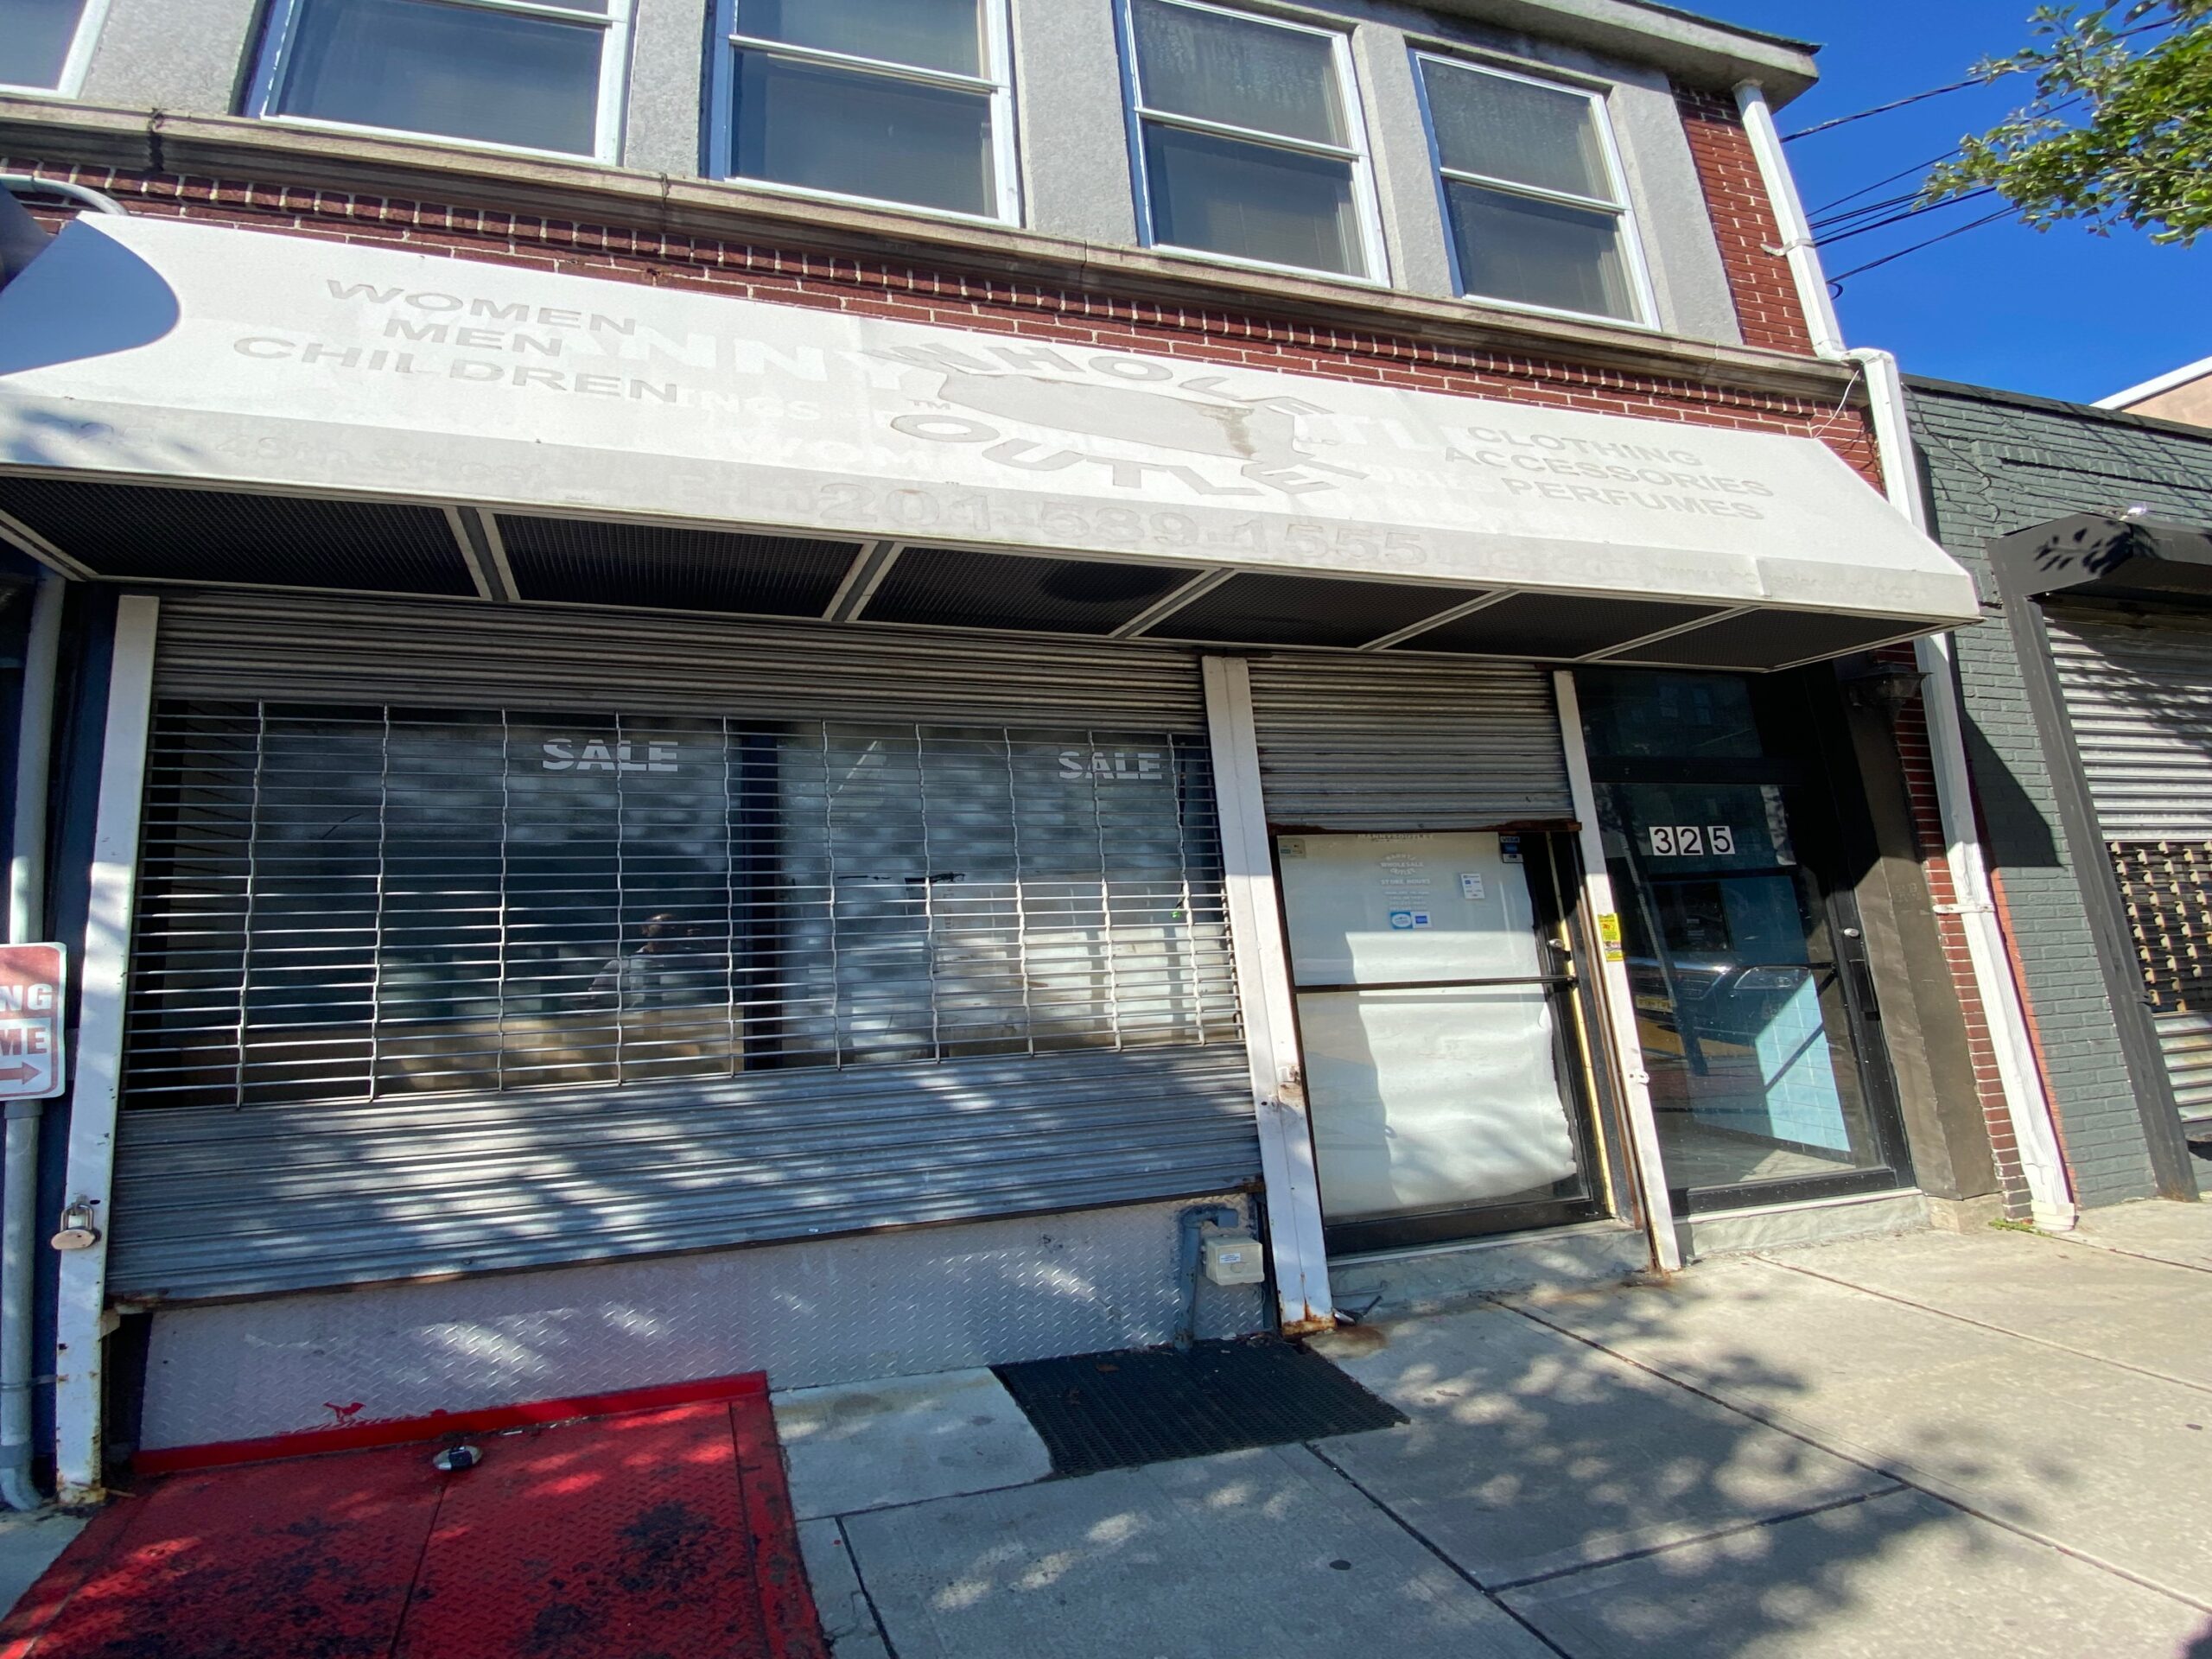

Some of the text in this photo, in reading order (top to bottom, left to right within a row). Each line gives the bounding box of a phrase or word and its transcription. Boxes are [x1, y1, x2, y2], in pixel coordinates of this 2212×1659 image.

[327, 280, 636, 335] WOMEN
[383, 319, 563, 357] MEN
[233, 337, 677, 403] CHILDREN
[1467, 426, 1703, 467] CLOTHING
[1445, 446, 1774, 499] ACCESSORIES
[1500, 477, 1765, 520] PERFUMES
[543, 738, 678, 772] SALE
[1058, 751, 1162, 779] SALE
[1654, 827, 1730, 854] 325
